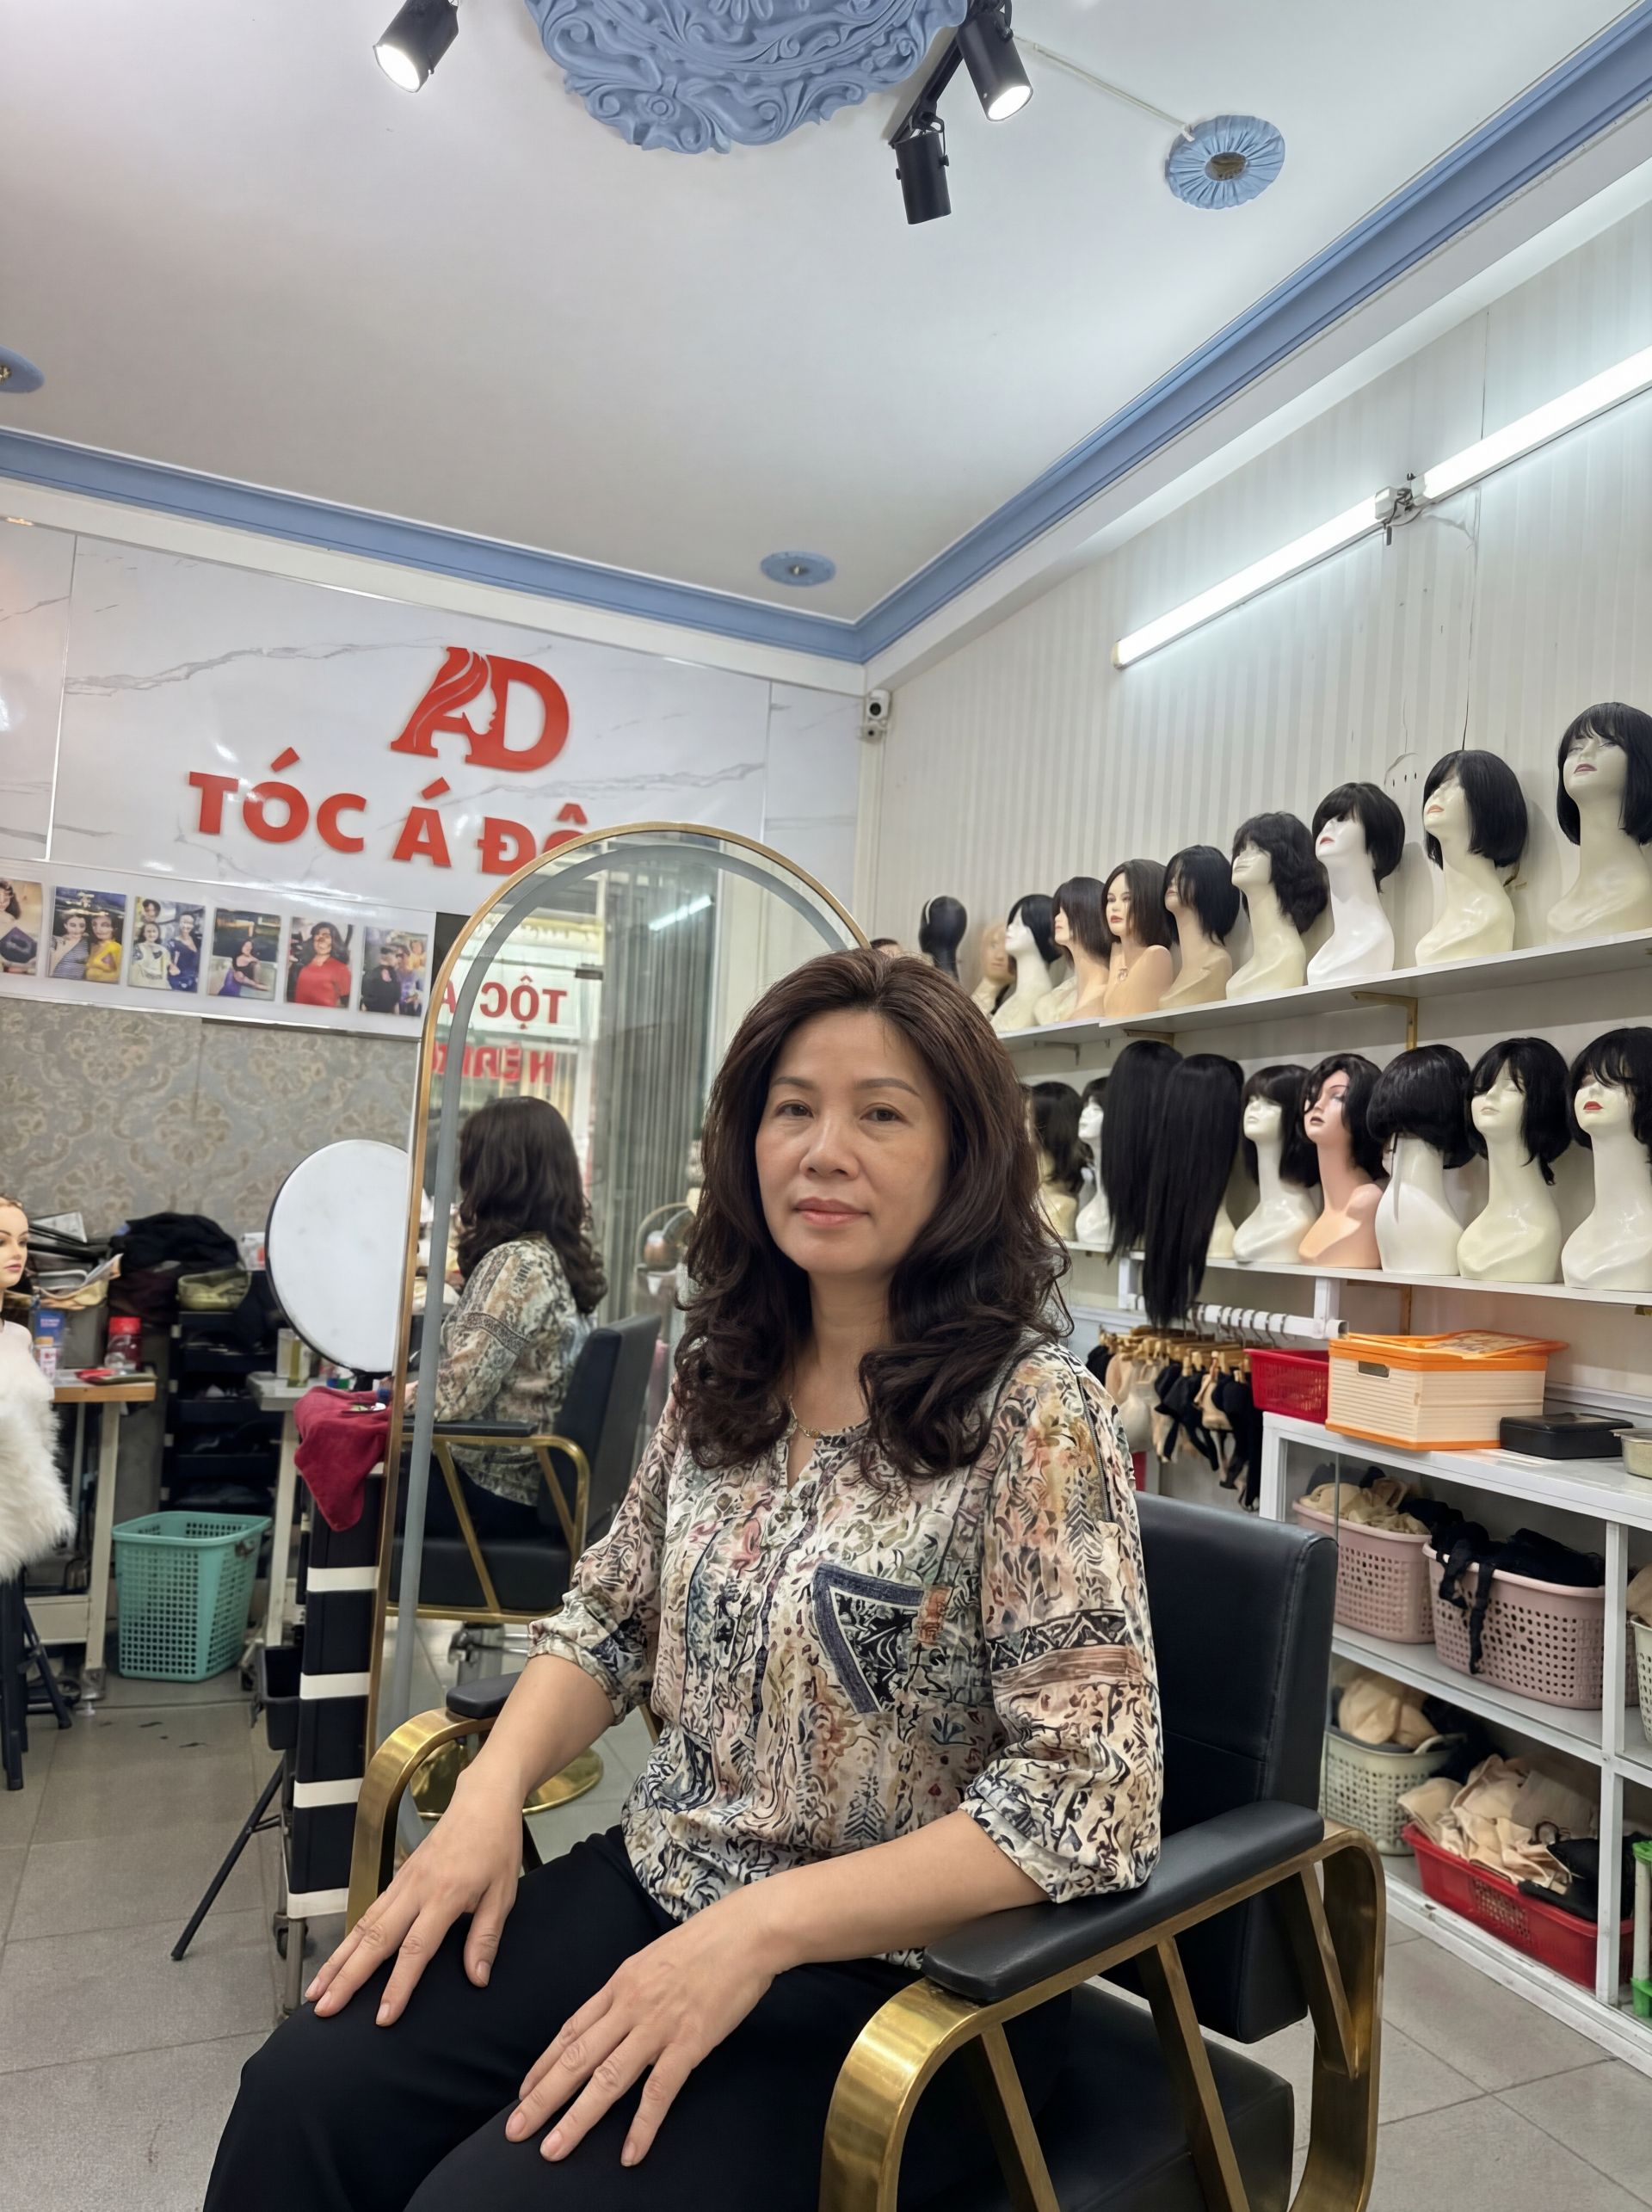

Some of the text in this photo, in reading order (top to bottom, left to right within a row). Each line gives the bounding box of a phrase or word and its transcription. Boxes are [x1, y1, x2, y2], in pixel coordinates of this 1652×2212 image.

[390, 646, 570, 773] AD
[188, 747, 367, 853] TÓC
[392, 777, 452, 867] Á
